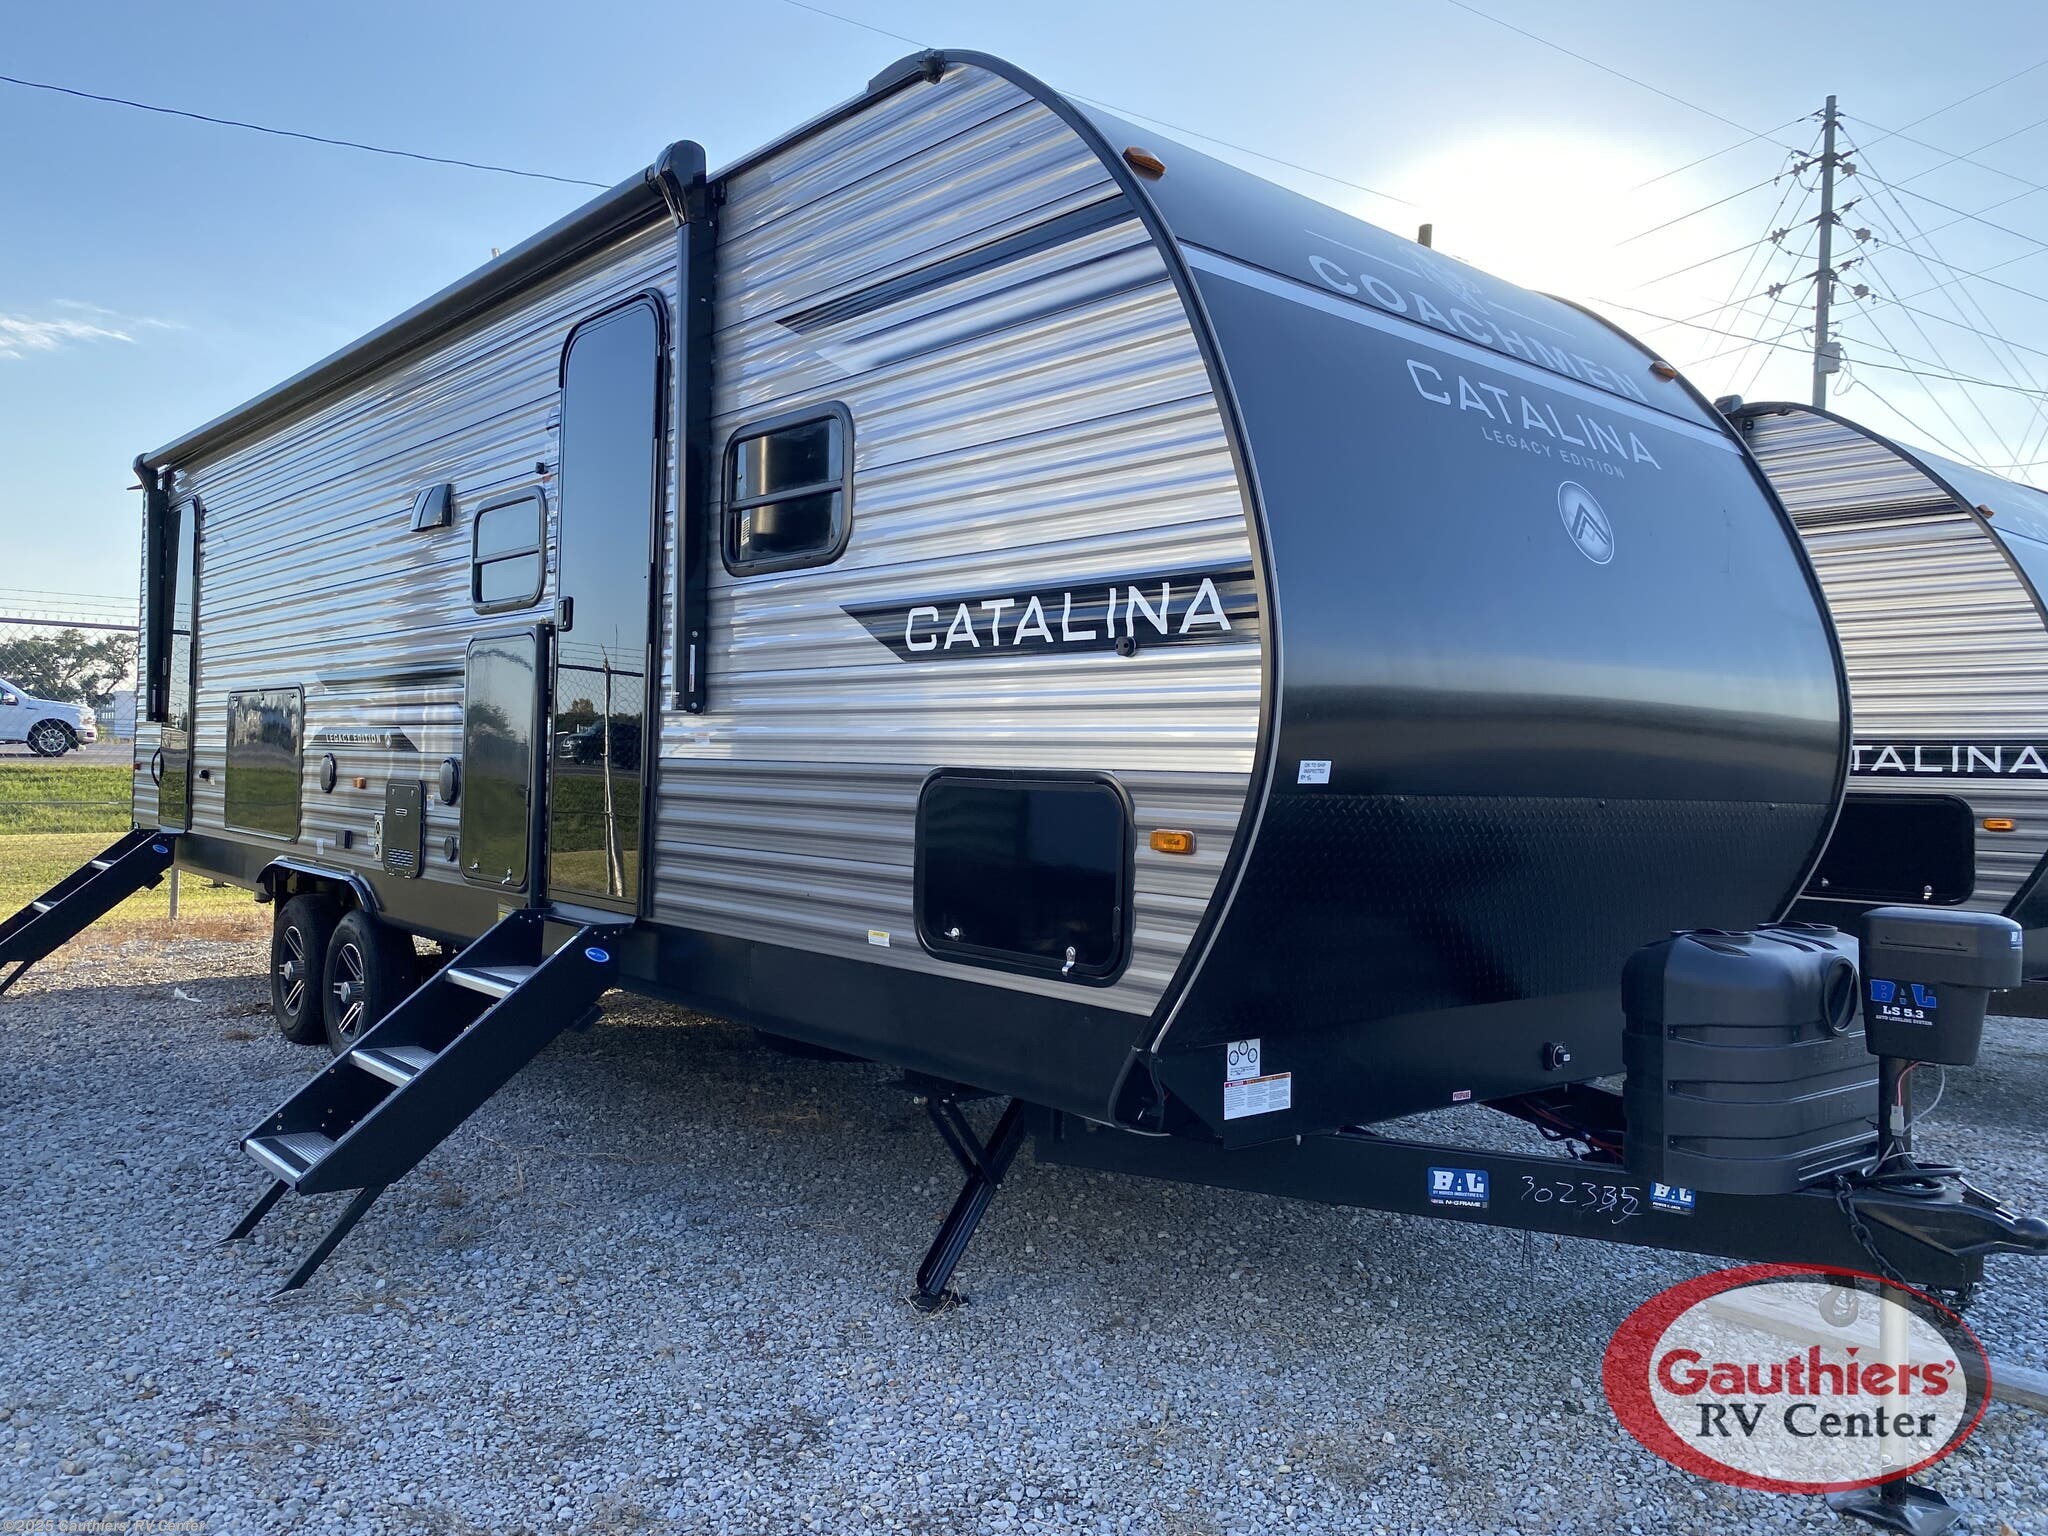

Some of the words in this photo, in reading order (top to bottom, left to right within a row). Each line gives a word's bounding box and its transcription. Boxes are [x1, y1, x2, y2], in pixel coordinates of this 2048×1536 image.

[1308, 254, 1649, 402] COACHMEN
[1406, 358, 1662, 470] CATALINA
[1481, 426, 1551, 458] LEGACY
[1559, 449, 1625, 479] EDITION
[905, 577, 1231, 651] CATALINA
[325, 733, 351, 743] LEGACY
[353, 733, 381, 744] EDITION
[1870, 979, 1937, 1009] BAL
[1882, 1005, 1900, 1016] LS
[1903, 1008, 1924, 1019] 5.3
[1432, 1170, 1485, 1193] BAL
[1653, 1182, 1692, 1203] BAL
